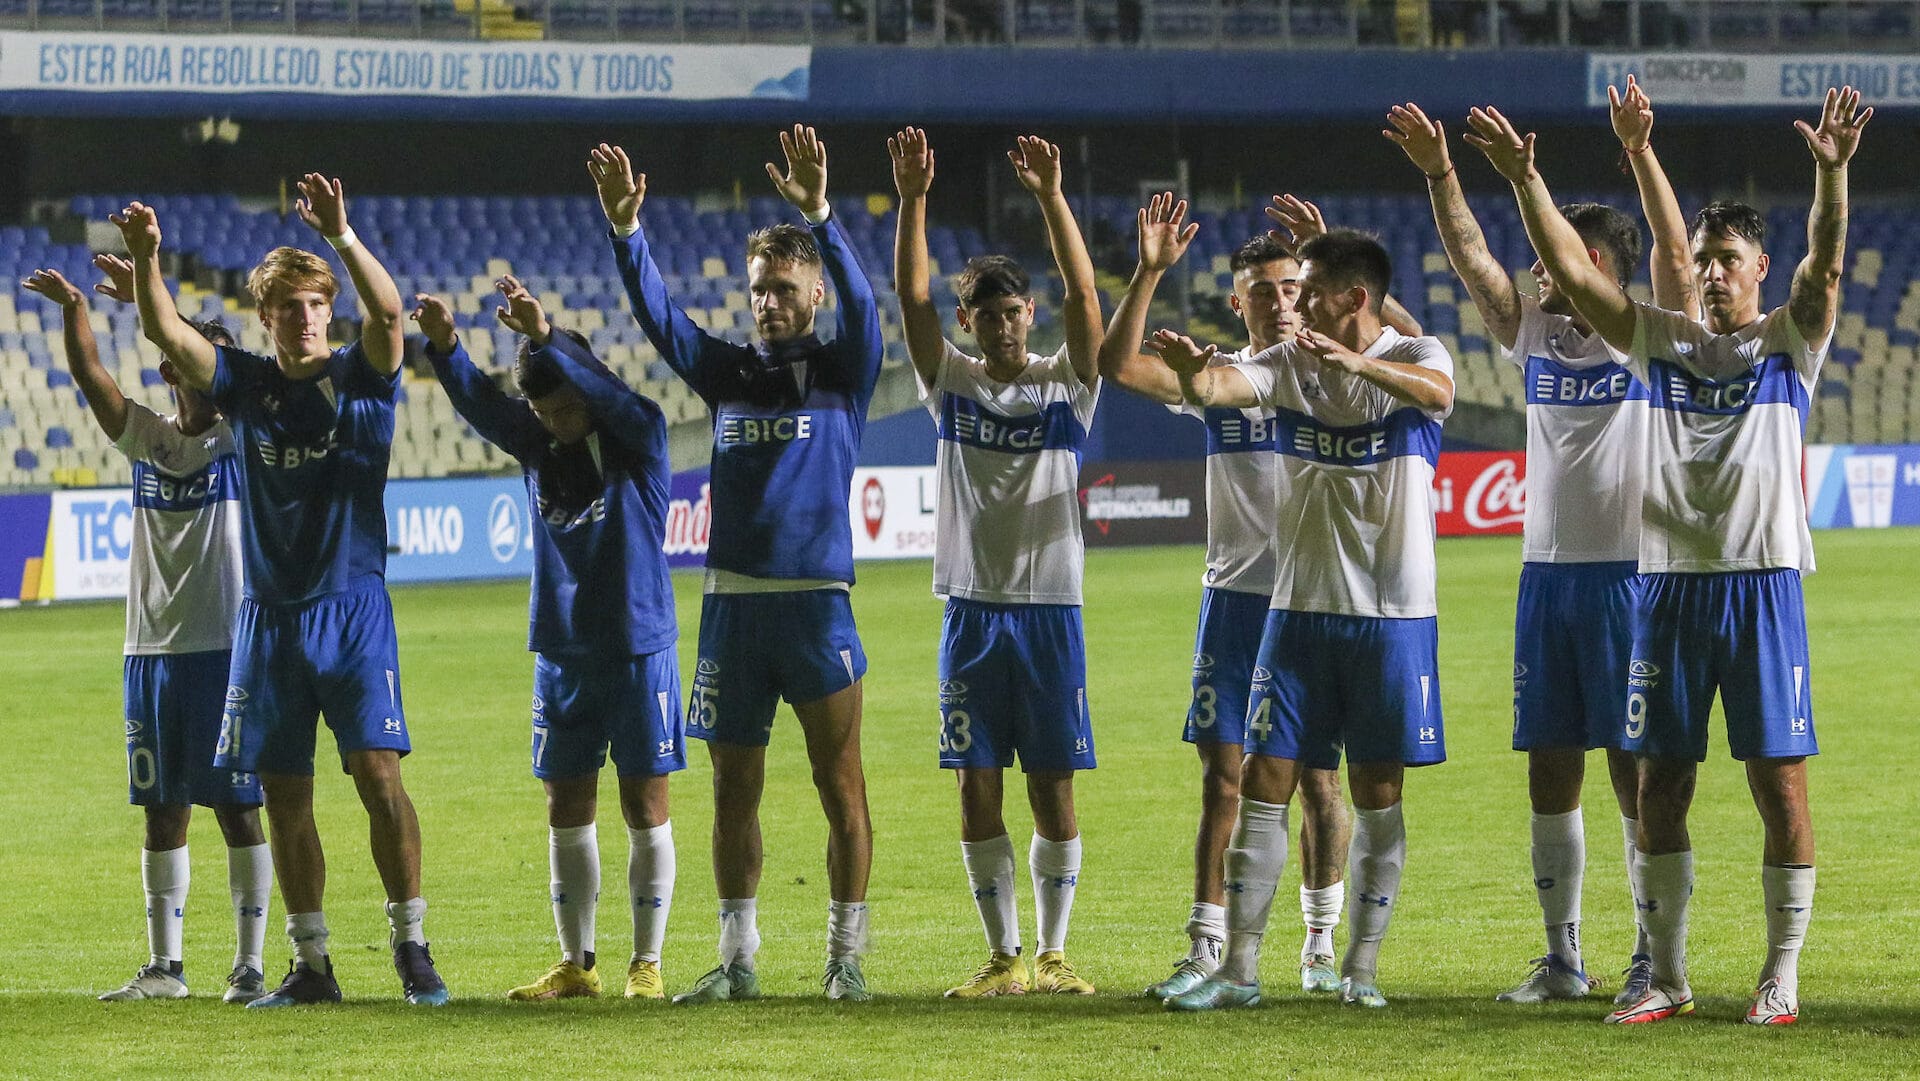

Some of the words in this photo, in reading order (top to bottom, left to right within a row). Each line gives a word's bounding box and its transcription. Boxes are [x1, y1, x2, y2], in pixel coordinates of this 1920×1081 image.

[38, 44, 116, 84] ESTER
[124, 45, 171, 84] ROA
[334, 49, 433, 89] ESTADIO
[441, 52, 470, 89] DE
[480, 52, 560, 90] TODAS
[569, 54, 584, 91] Y
[591, 54, 673, 92] TODOS
[1781, 63, 1889, 97] ESTADIO
[1560, 373, 1626, 401] BICE
[744, 415, 811, 443] BICE
[980, 418, 1043, 448] BICE
[1316, 431, 1387, 459] BICE
[396, 505, 464, 555] JAKO
[1190, 685, 1217, 729] 3
[1244, 697, 1273, 742] 4
[1626, 693, 1647, 739] 9
[216, 713, 242, 757] 81
[532, 724, 548, 767] 7
